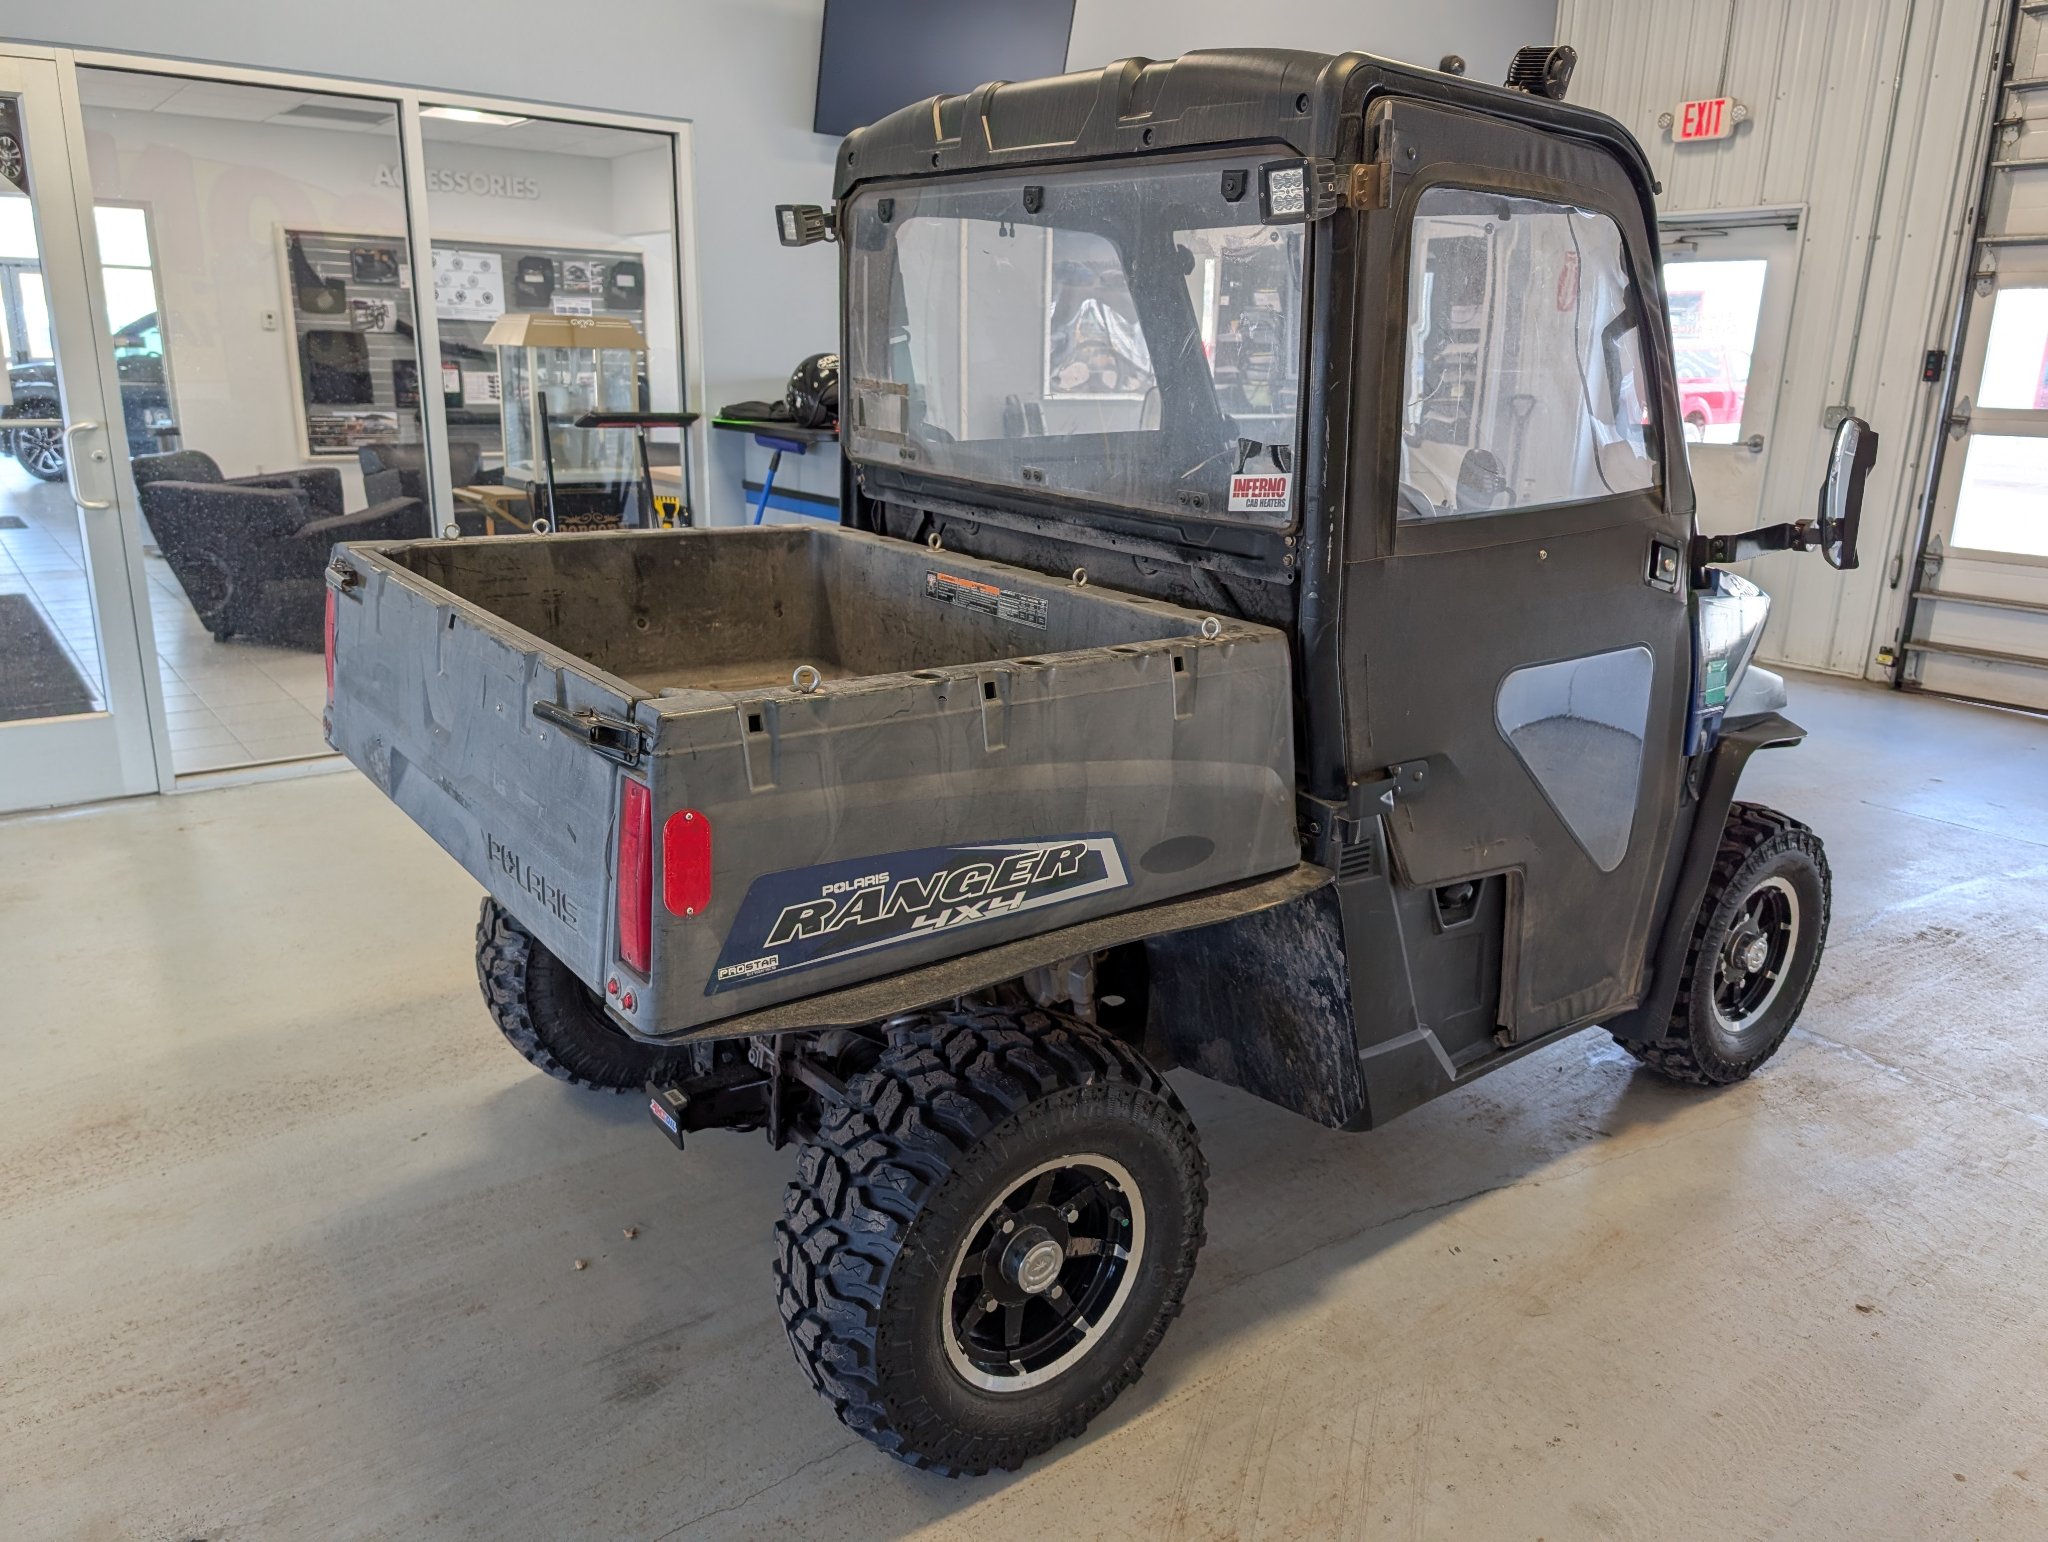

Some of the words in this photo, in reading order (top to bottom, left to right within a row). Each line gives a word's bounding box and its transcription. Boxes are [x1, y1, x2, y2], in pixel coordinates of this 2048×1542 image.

[1681, 100, 1725, 138] EXIT
[373, 165, 540, 200] ACESSORIES
[1232, 477, 1287, 498] INFERNO
[1245, 498, 1259, 508] CAB
[1259, 498, 1286, 508] HEATERS
[487, 832, 578, 933] POLARIS
[762, 840, 1088, 949] RANGER
[822, 872, 890, 896] POLARIS
[911, 890, 1027, 930] 4X4
[718, 954, 779, 980] PROSTAR
